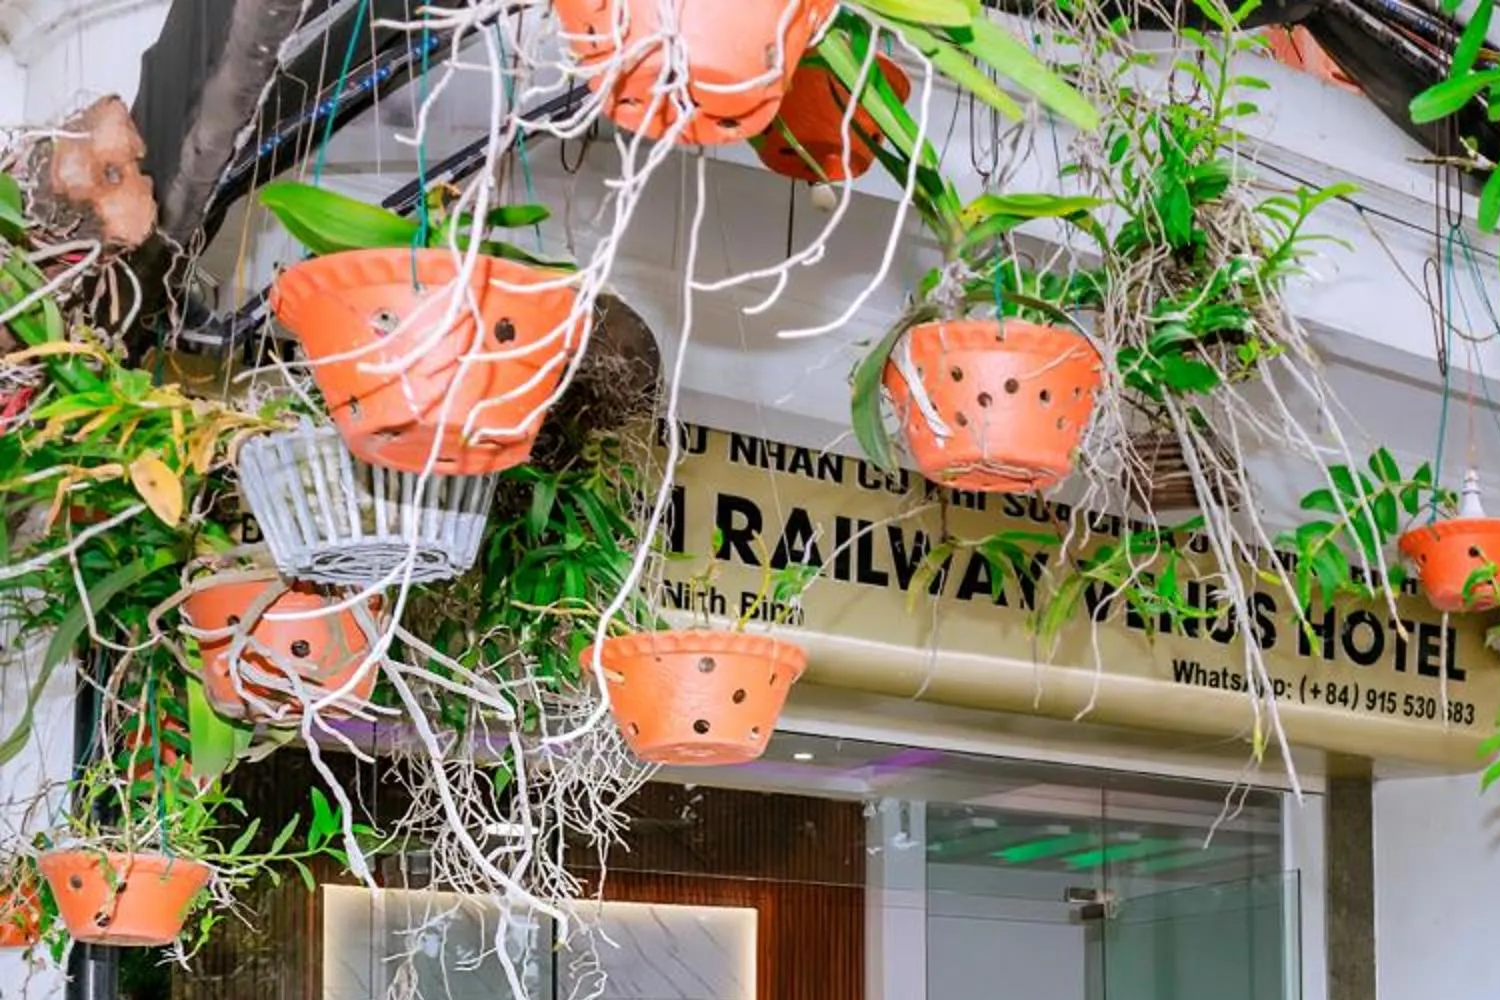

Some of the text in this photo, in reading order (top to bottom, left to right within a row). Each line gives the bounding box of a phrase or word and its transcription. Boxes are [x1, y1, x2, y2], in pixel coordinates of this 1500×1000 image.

[1299, 598, 1466, 682] HOTEL
[1366, 689, 1397, 714] 915
[1403, 695, 1436, 719] 530
